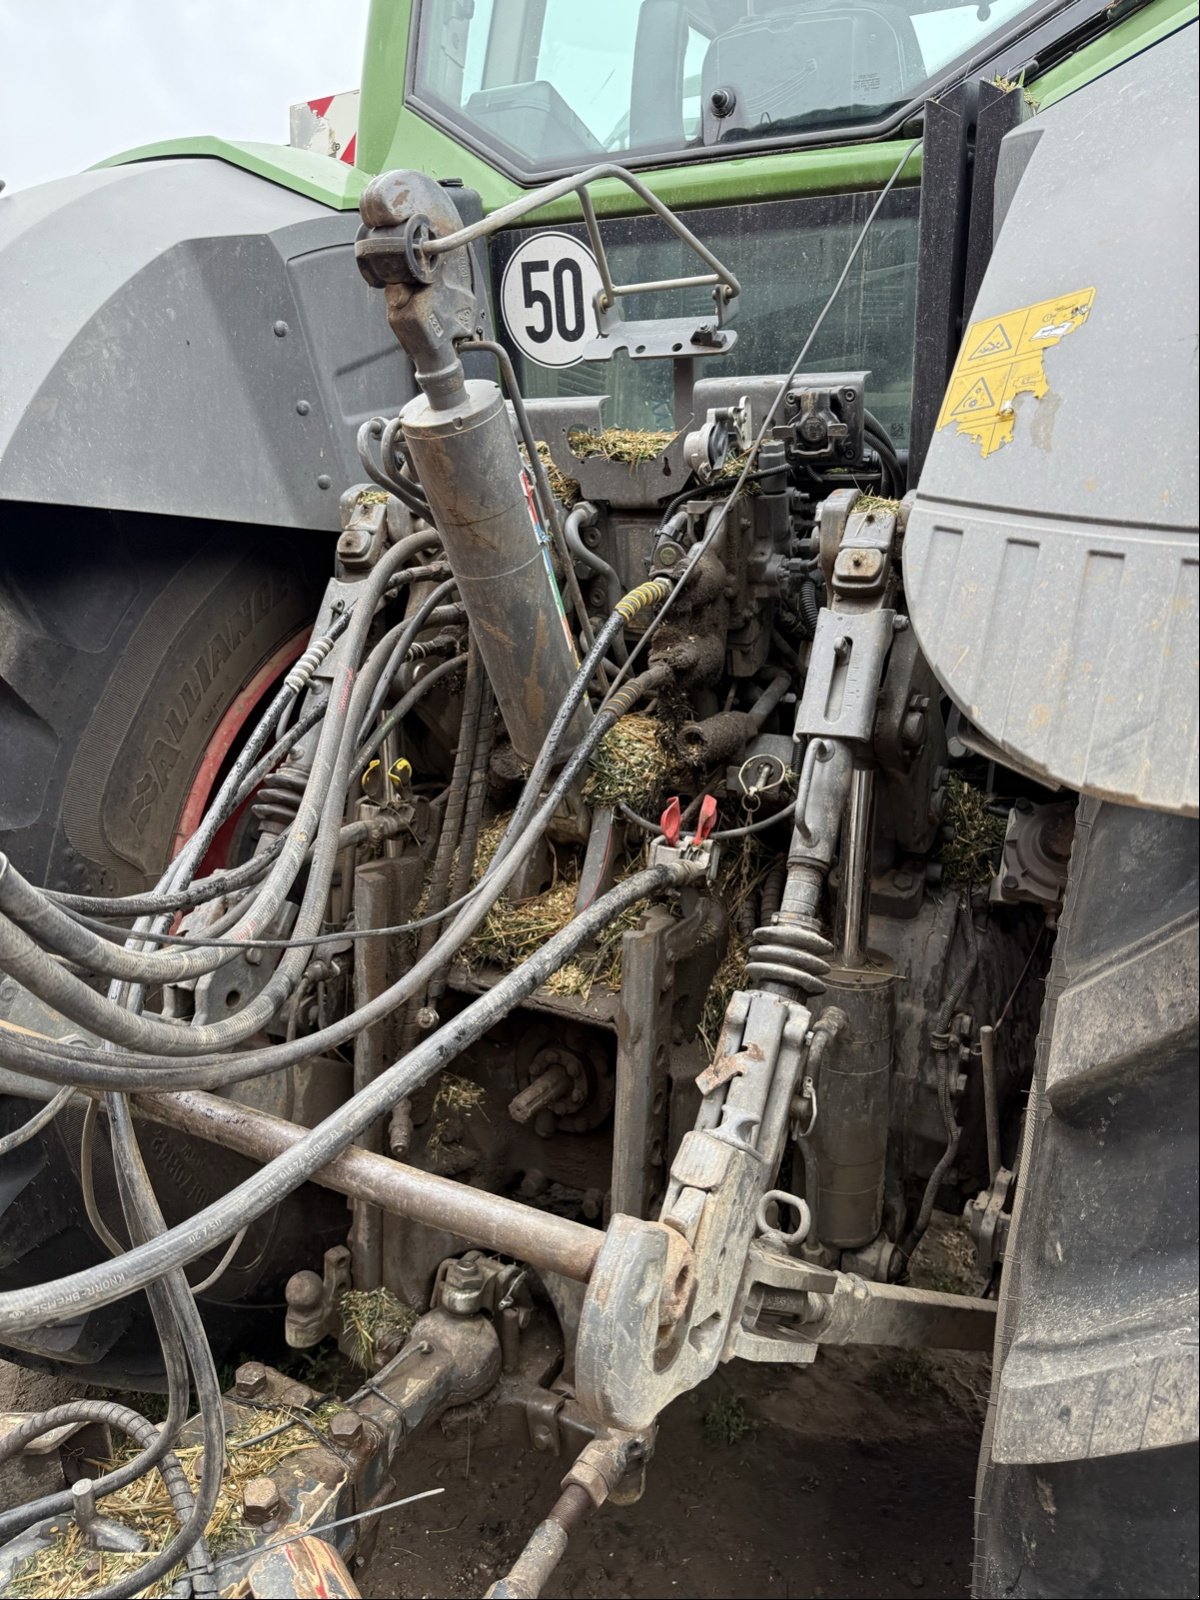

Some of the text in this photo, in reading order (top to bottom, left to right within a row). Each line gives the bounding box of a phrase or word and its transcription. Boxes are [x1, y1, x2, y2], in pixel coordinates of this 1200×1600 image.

[521, 257, 586, 344] 50
[148, 574, 289, 793] ALLIANCE
[31, 1272, 126, 1315] KNORR-BREMSE
